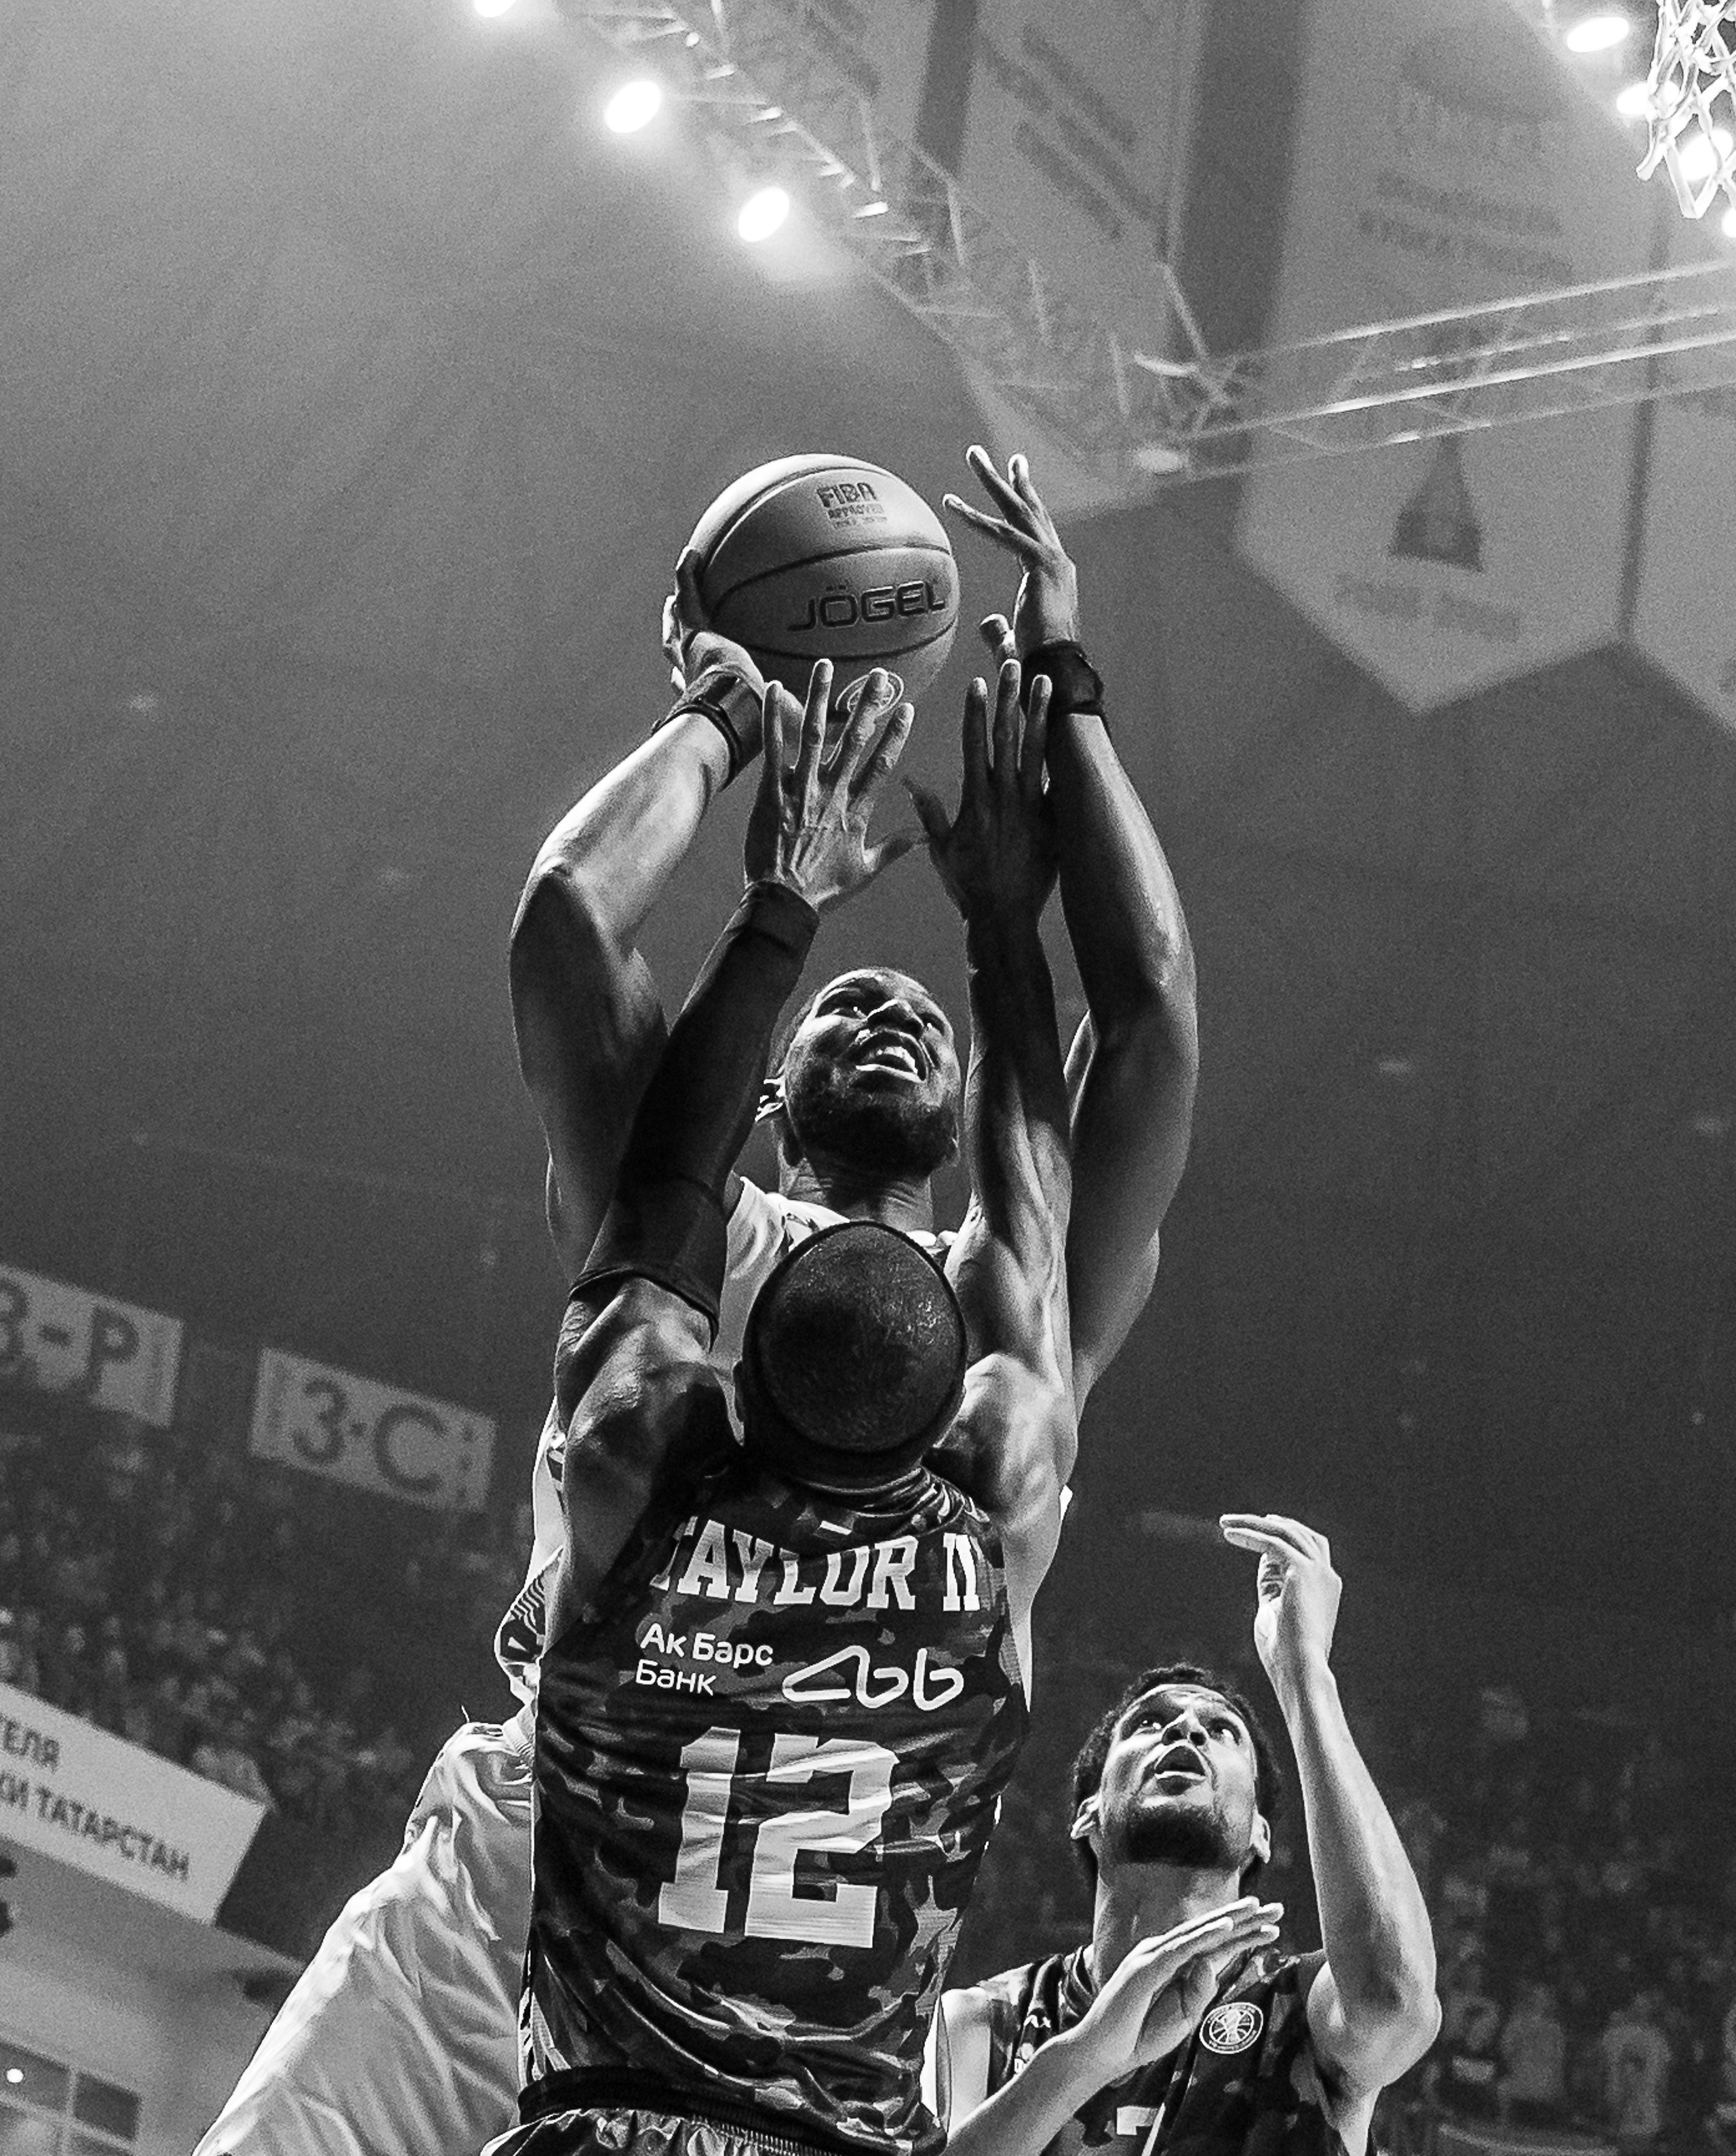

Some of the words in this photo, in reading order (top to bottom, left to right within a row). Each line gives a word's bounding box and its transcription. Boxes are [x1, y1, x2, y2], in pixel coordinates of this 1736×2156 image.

[816, 483, 877, 508] FIBA
[786, 580, 946, 632] JÖGEL
[639, 1622, 688, 1658] Ак
[692, 1632, 774, 1669] Барс
[635, 1658, 717, 1696] Банк
[35, 1783, 190, 1883] ТАТАРСТАН
[658, 1725, 901, 1949] 12
